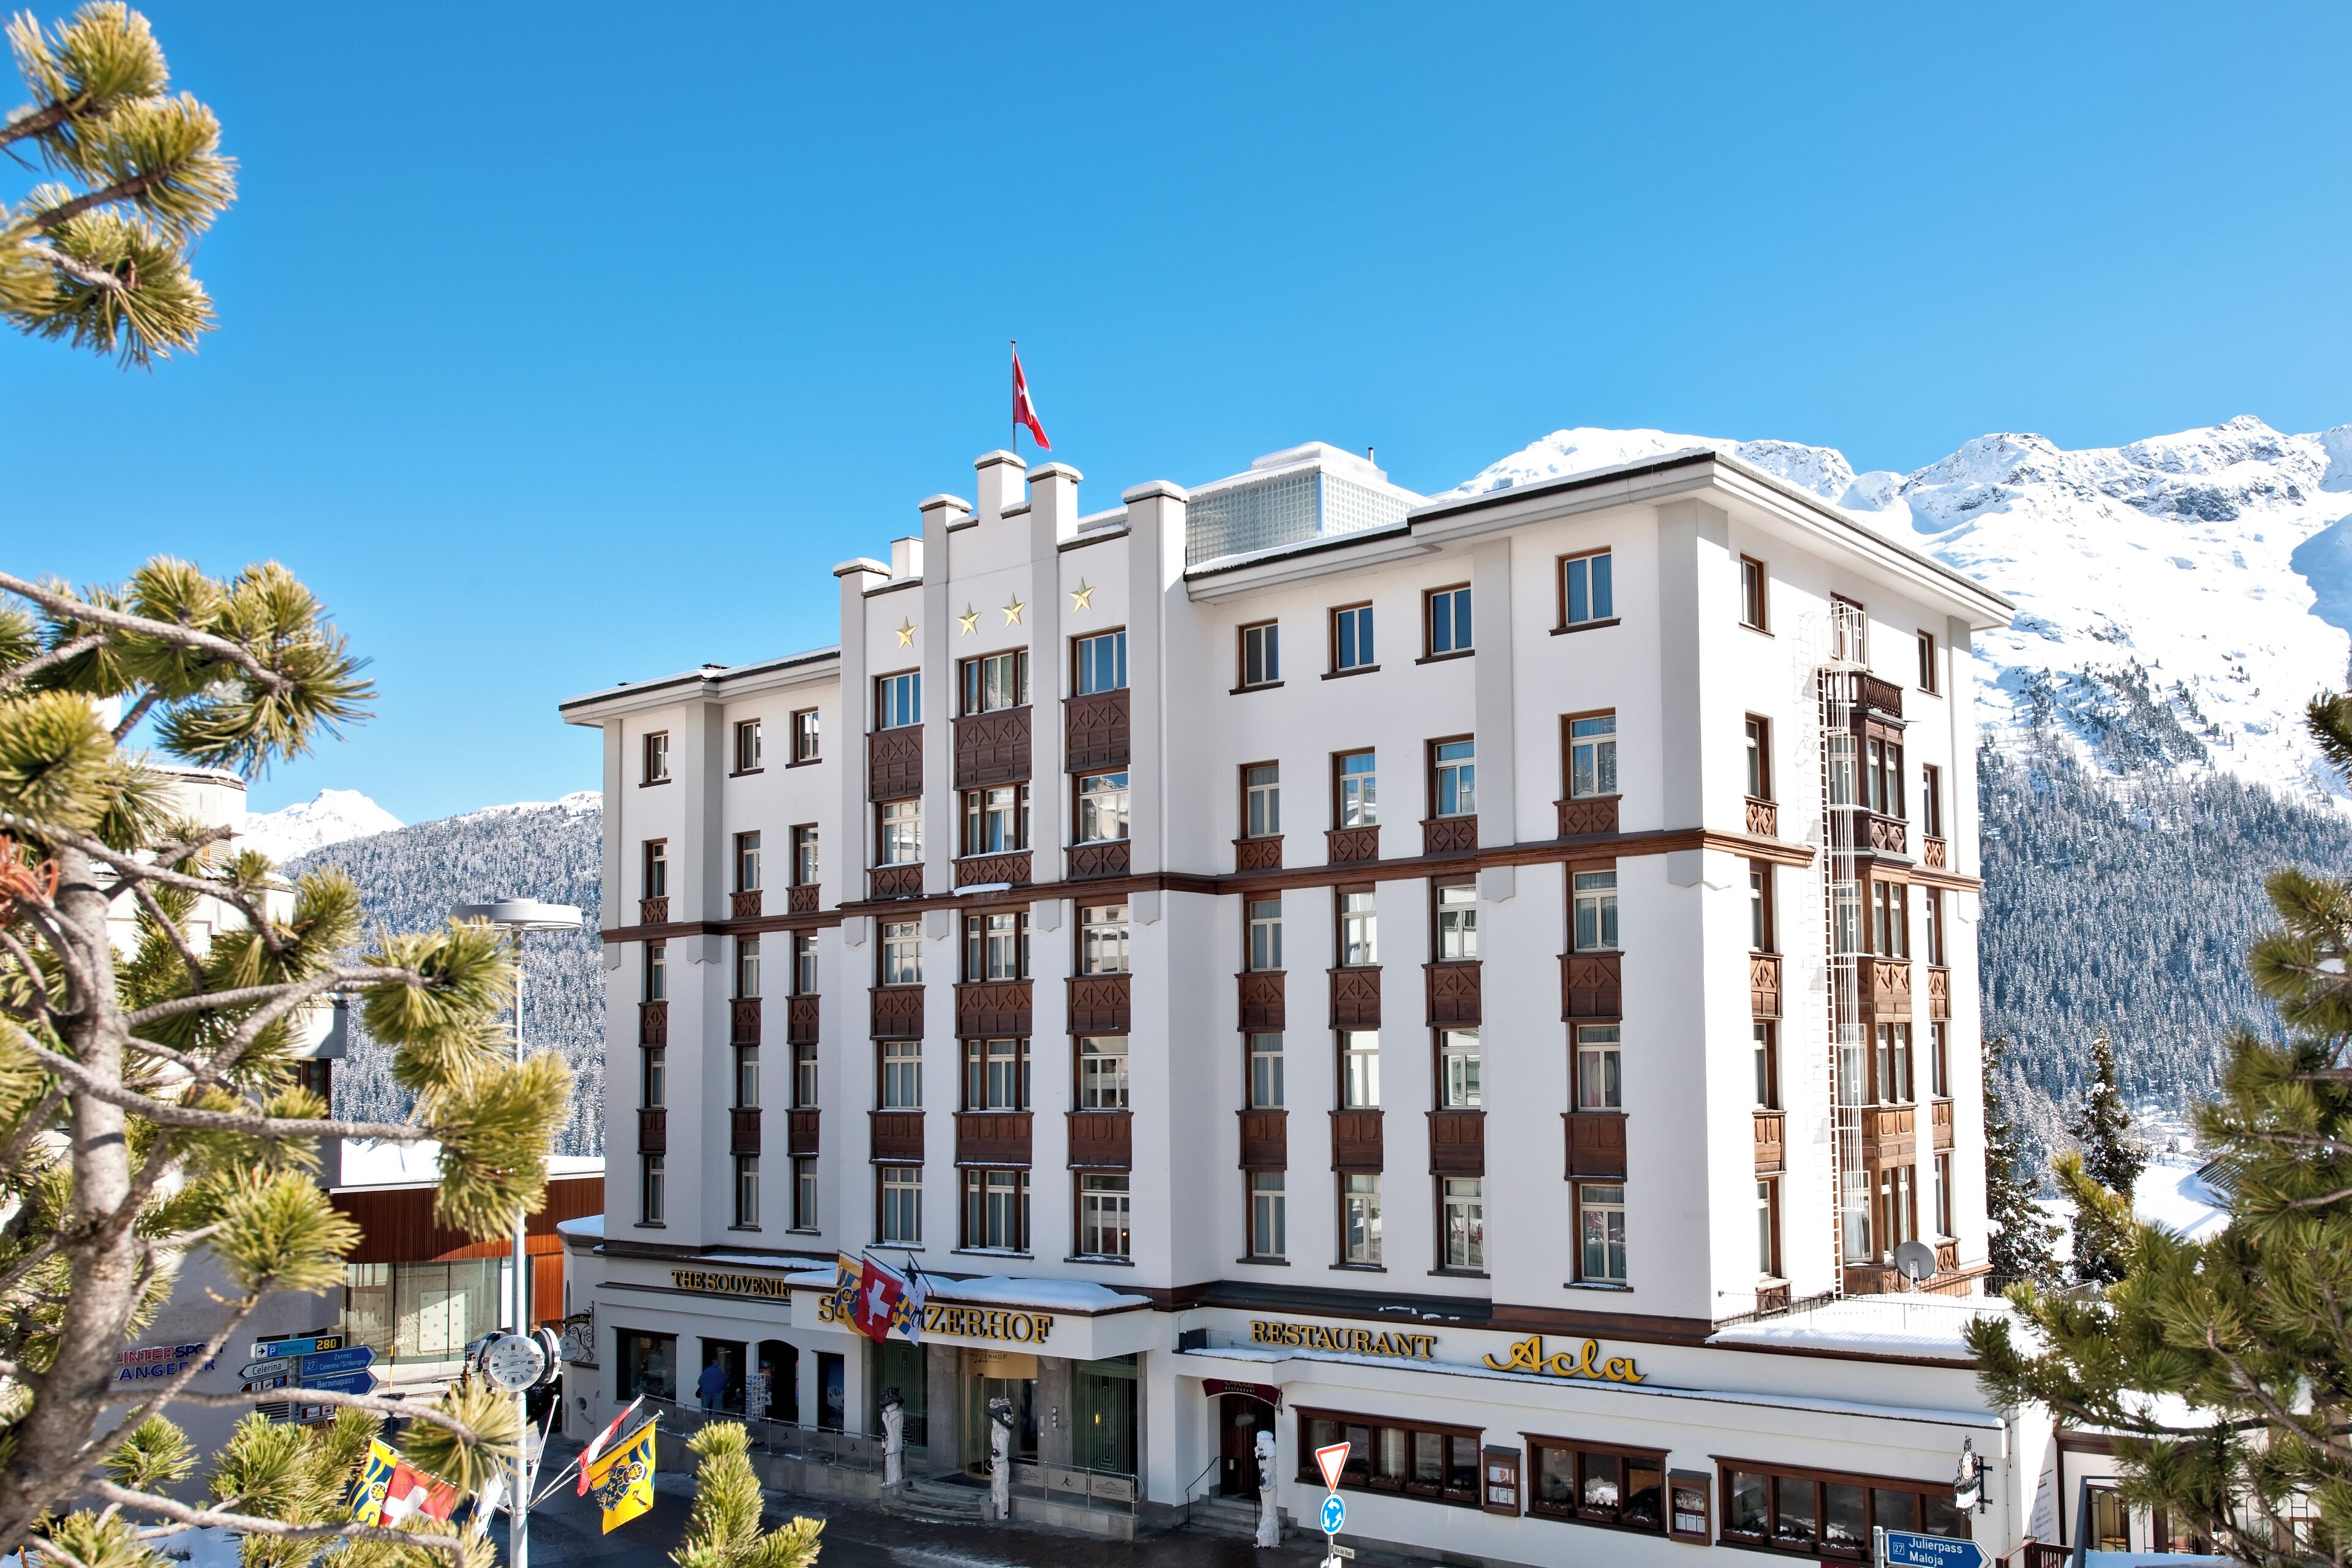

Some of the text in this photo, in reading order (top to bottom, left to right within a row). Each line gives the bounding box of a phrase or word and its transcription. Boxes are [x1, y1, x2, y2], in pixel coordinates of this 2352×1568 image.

[671, 1270, 703, 1289] THE
[818, 1295, 1053, 1343] SZERHOF
[316, 1338, 337, 1351] 280
[1249, 1320, 1437, 1359] RESTAURANT
[123, 1341, 227, 1365] INTERSPOT
[1482, 1335, 1648, 1383] Acla
[119, 1359, 215, 1381] ANGER
[252, 1363, 282, 1375] Celerina
[307, 1360, 315, 1370] 27
[317, 1378, 355, 1389] Berninapass
[1894, 1544, 1904, 1553] 27
[1909, 1537, 1963, 1554] Julierpass
[1909, 1551, 1943, 1567] Maloja
